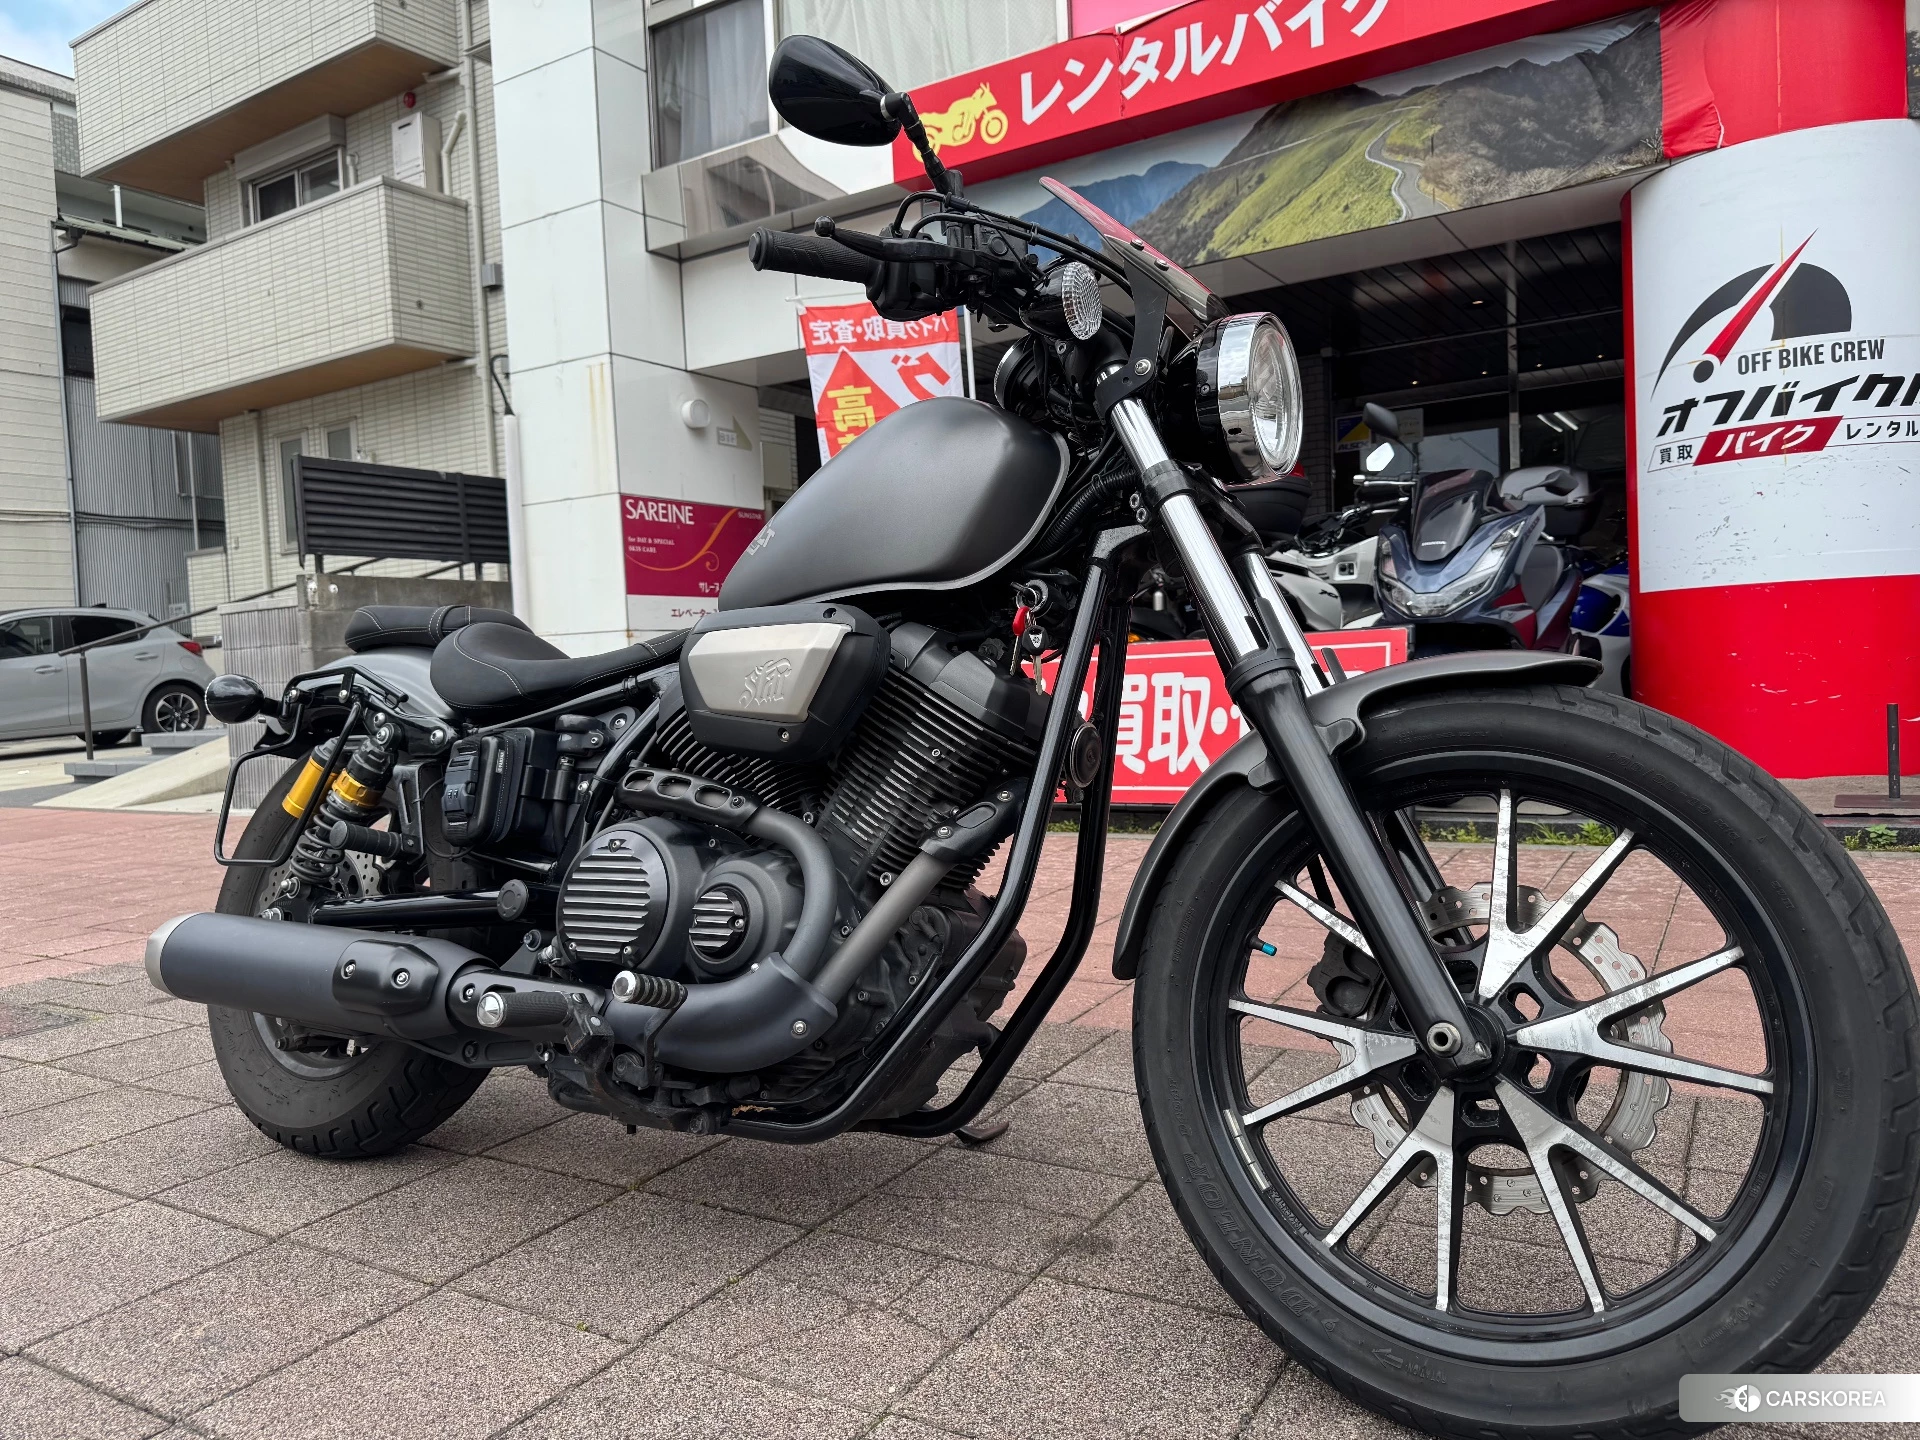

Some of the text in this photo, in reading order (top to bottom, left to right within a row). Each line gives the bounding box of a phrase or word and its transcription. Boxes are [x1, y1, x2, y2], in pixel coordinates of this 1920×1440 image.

[1020, 0, 1389, 126] レンタルバイク
[1737, 338, 1885, 376] OFF BIKE CREW
[1659, 420, 1919, 465] 買取 バイク レンタル
[626, 500, 694, 524] SAREINE
[671, 608, 718, 618] エレベーター
[1184, 1152, 1317, 1317] DUNLOP
